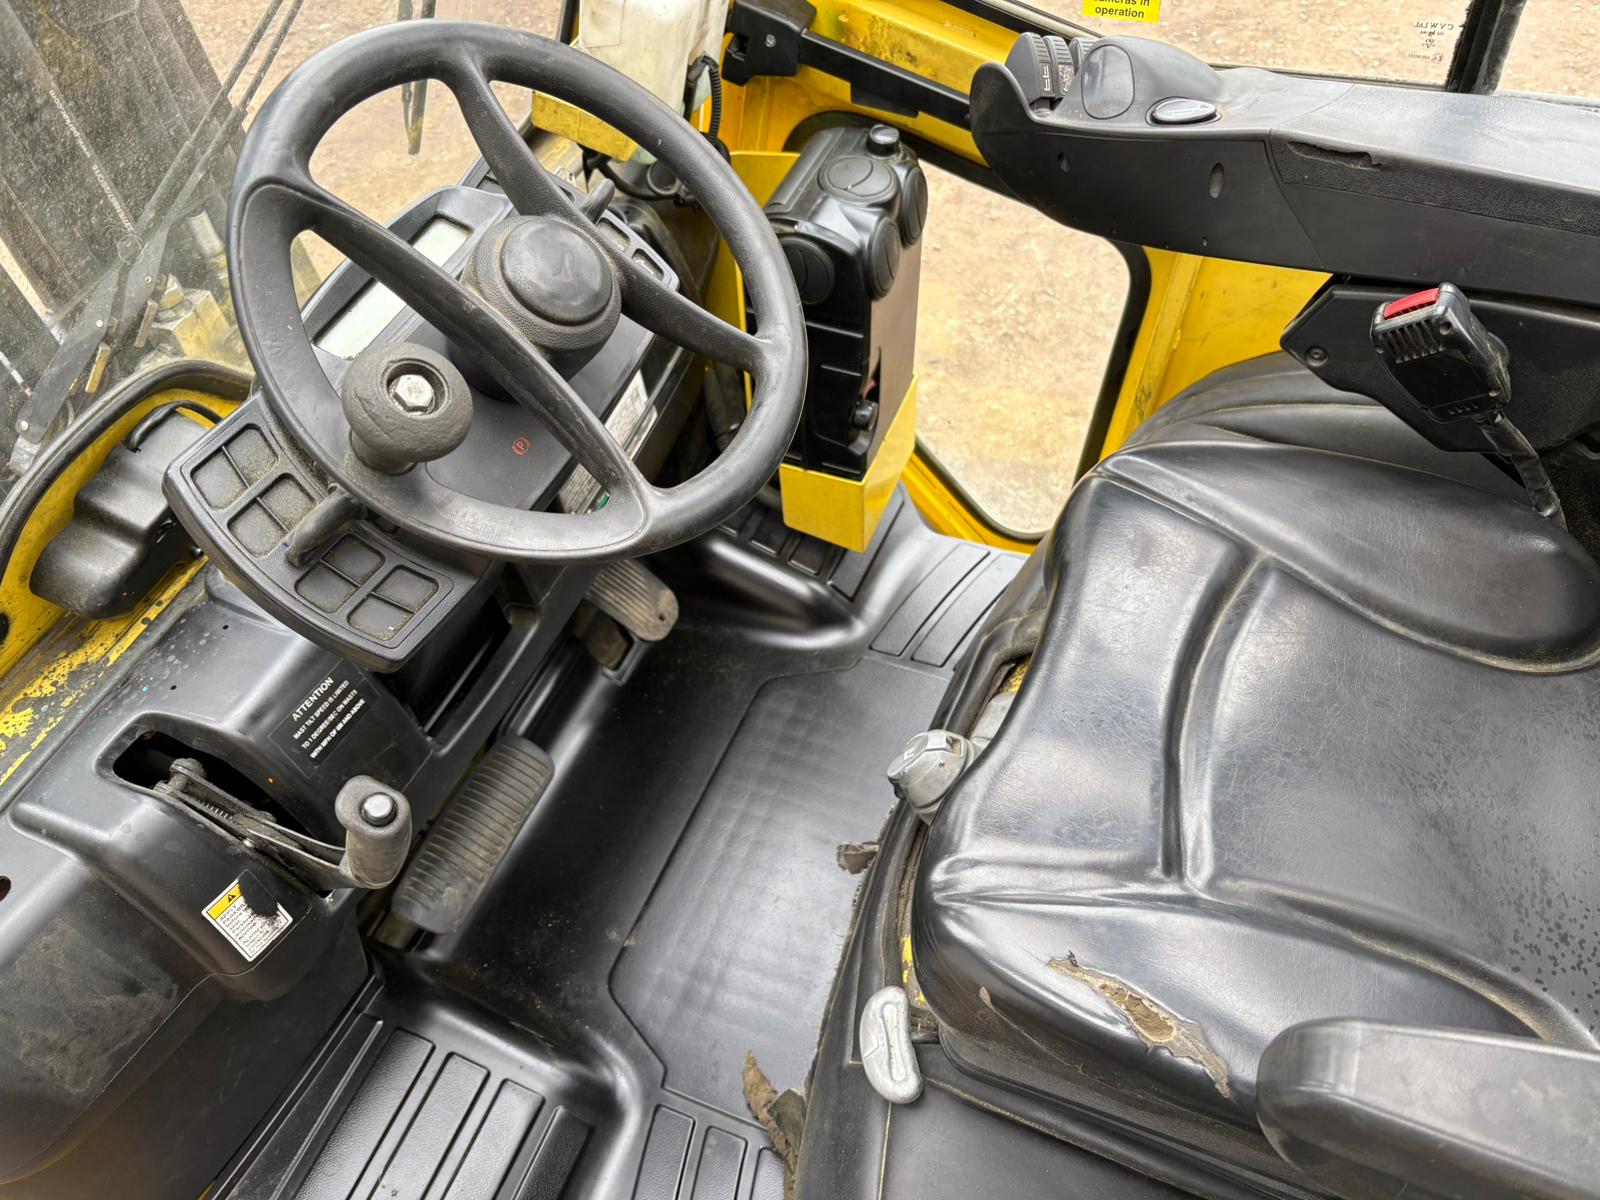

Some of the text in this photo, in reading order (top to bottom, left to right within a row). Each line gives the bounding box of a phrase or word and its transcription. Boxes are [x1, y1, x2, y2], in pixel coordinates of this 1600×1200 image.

[1095, 6, 1144, 18] operation
[48, 88, 92, 159] www.parker.com
[292, 677, 335, 721] ATTENTION
[293, 725, 307, 739] MAST
[304, 715, 316, 726] TILT
[314, 701, 330, 718] SPEED
[332, 680, 350, 698] LIMITED
[301, 741, 310, 749] TO
[336, 704, 345, 712] ON
[342, 689, 358, 705] MASTS
[310, 745, 323, 759] WITH
[329, 729, 337, 737] OF
[342, 713, 352, 723] AND
[350, 698, 366, 714] ABOVE
